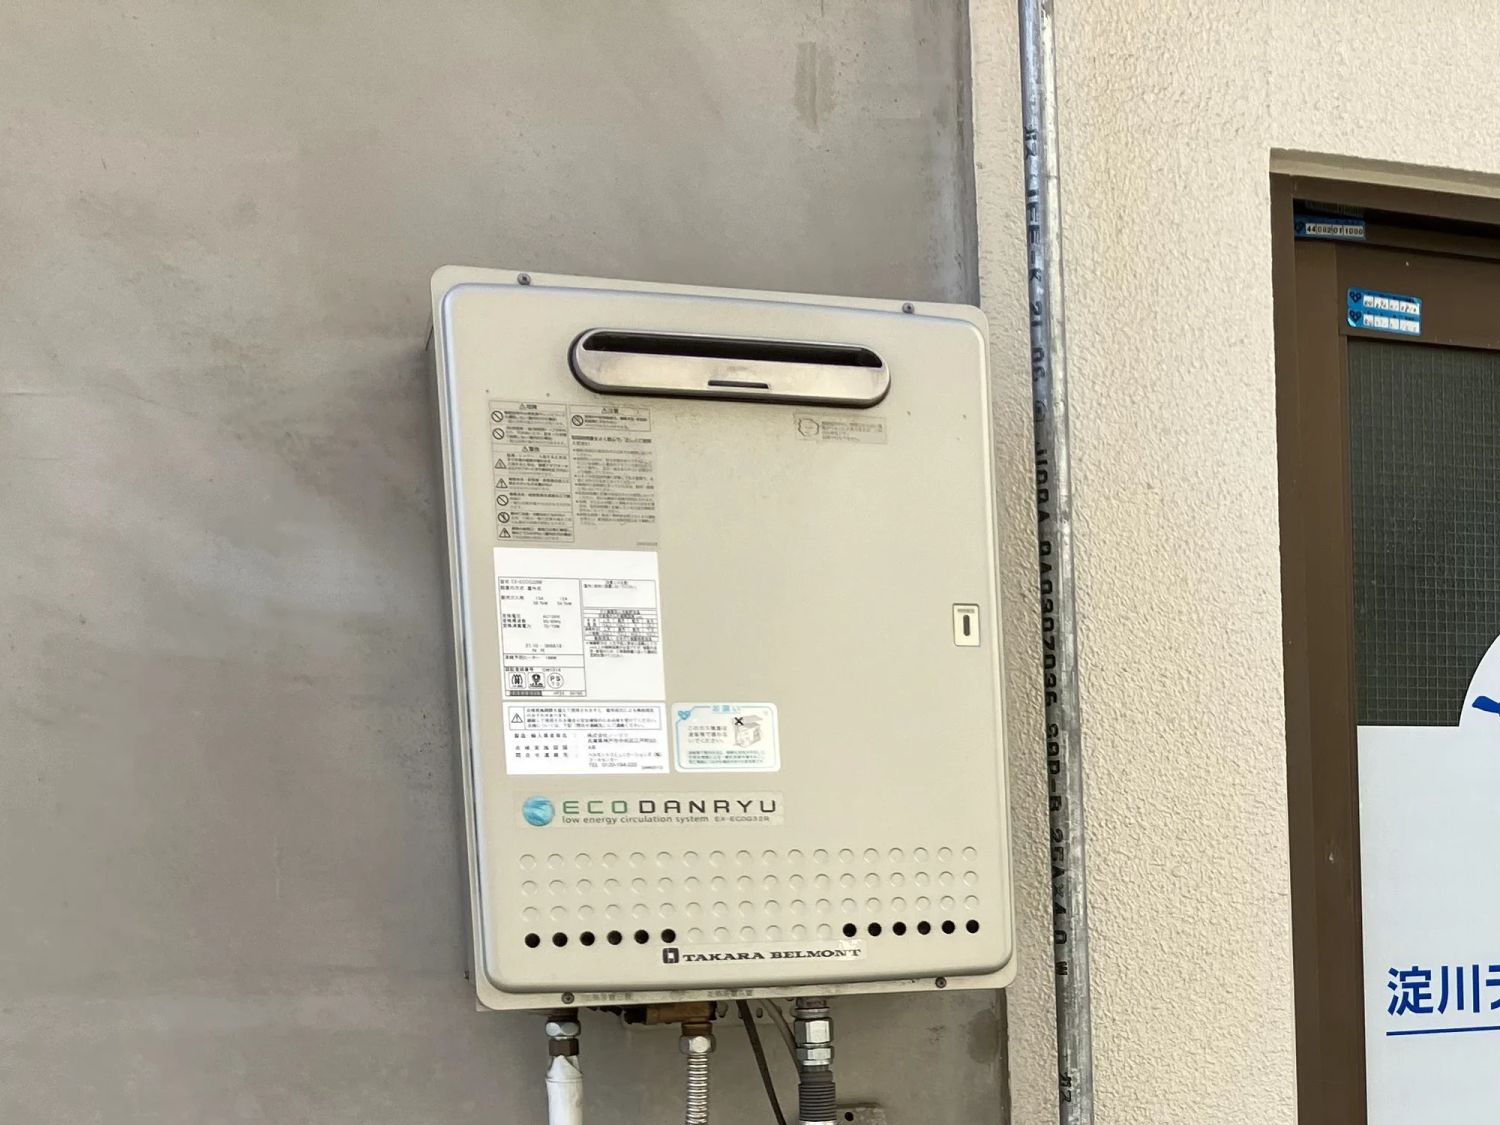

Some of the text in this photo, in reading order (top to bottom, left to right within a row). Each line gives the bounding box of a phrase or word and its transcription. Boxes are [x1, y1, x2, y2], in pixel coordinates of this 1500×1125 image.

[562, 816, 580, 824] low
[583, 817, 617, 825] energy
[620, 815, 673, 823] circulation
[676, 816, 709, 824] system
[683, 949, 861, 962] TAKARA BELMONT
